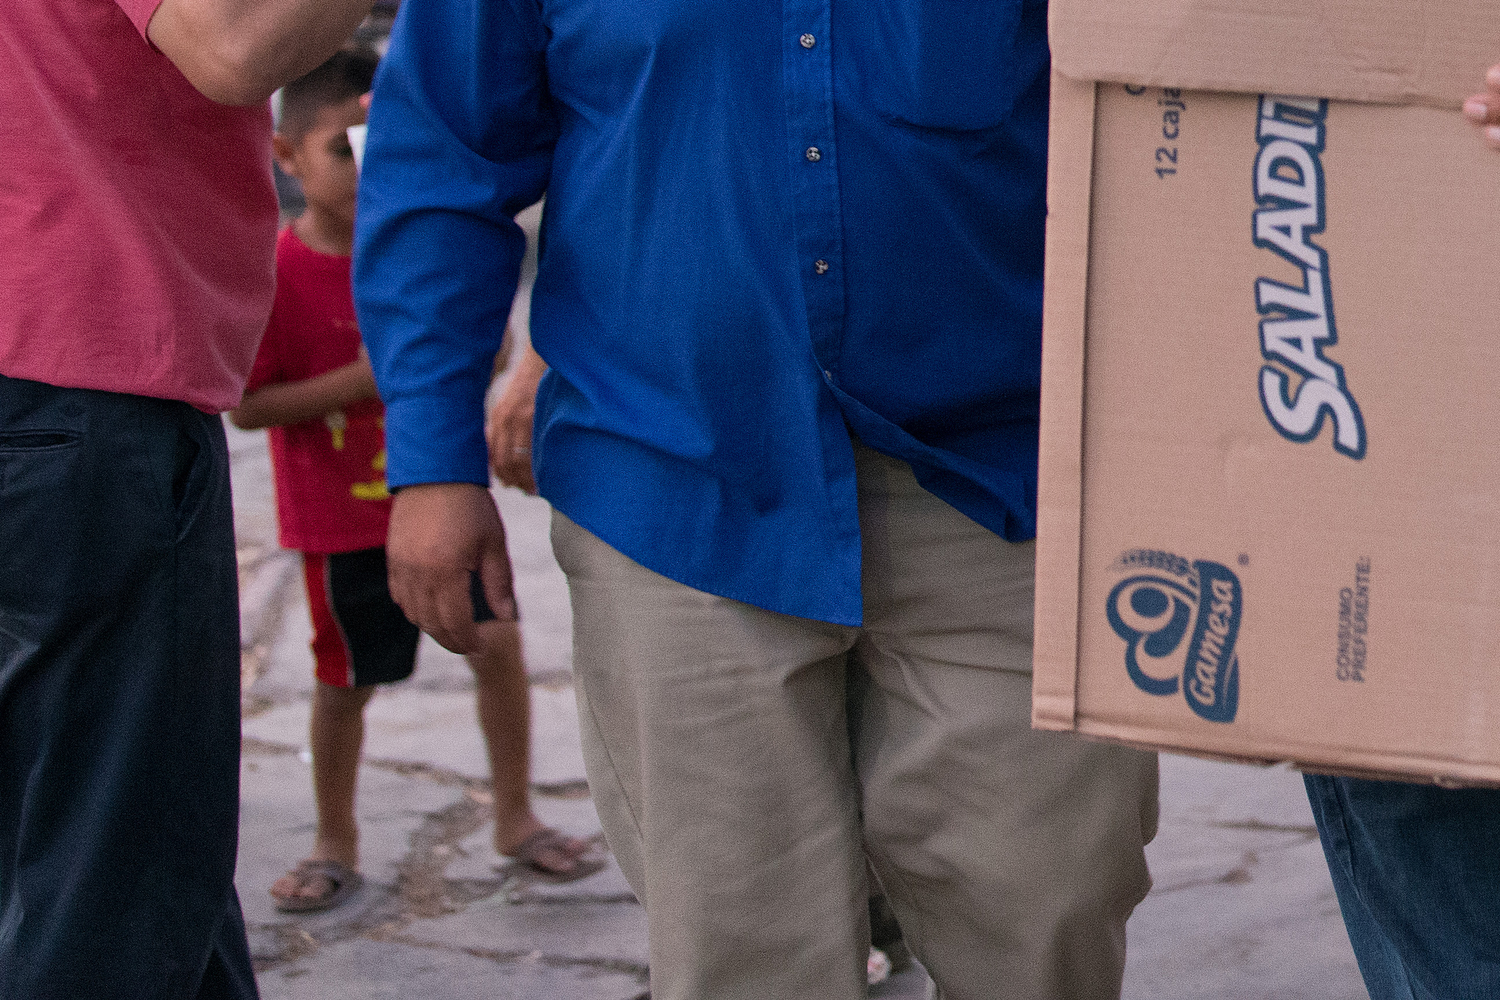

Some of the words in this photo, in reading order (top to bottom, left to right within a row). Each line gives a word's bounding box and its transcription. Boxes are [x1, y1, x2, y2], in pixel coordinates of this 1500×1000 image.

[1155, 146, 1179, 180] 12
[1188, 578, 1235, 706] Gamesa
[1336, 587, 1353, 682] CONSUMO
[1351, 555, 1371, 684] PREFERENTE:
